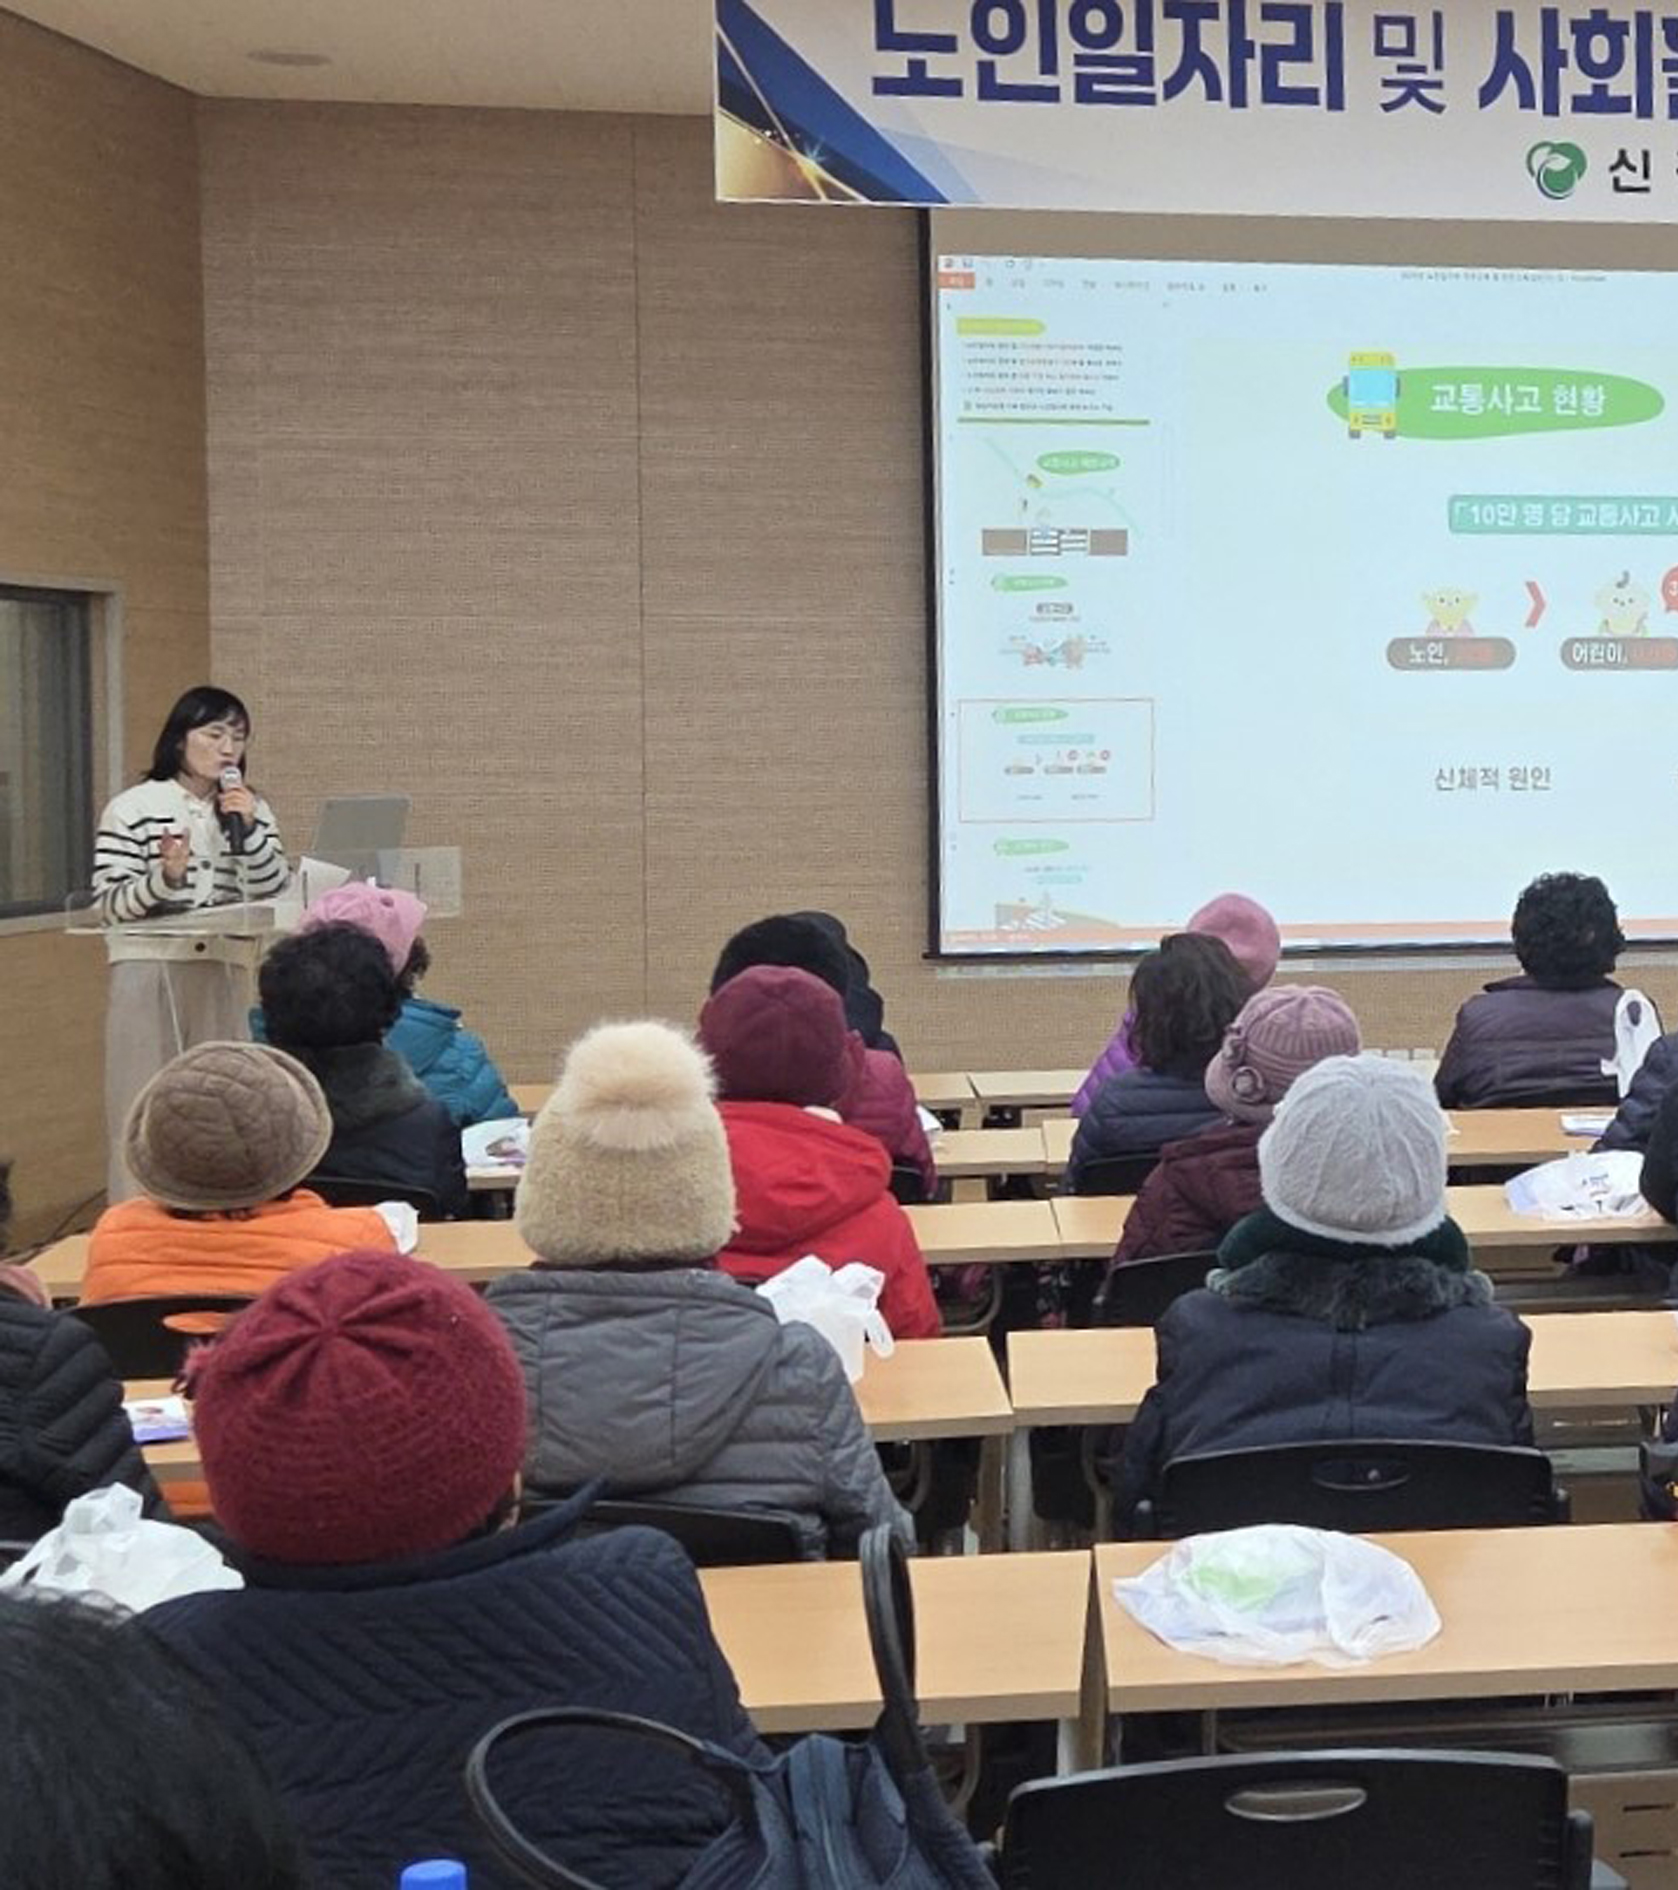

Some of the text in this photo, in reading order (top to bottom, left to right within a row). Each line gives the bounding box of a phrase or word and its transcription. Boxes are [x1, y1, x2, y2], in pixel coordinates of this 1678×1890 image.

[872, 0, 1345, 111] 노인일자리
[1373, 10, 1446, 114] 및
[1430, 382, 1607, 417] 교통사고 현황
[1523, 504, 1545, 527] 명
[1551, 504, 1571, 527] 당
[1576, 504, 1660, 528] 교통사고
[1435, 766, 1551, 792] 신체적 원인
